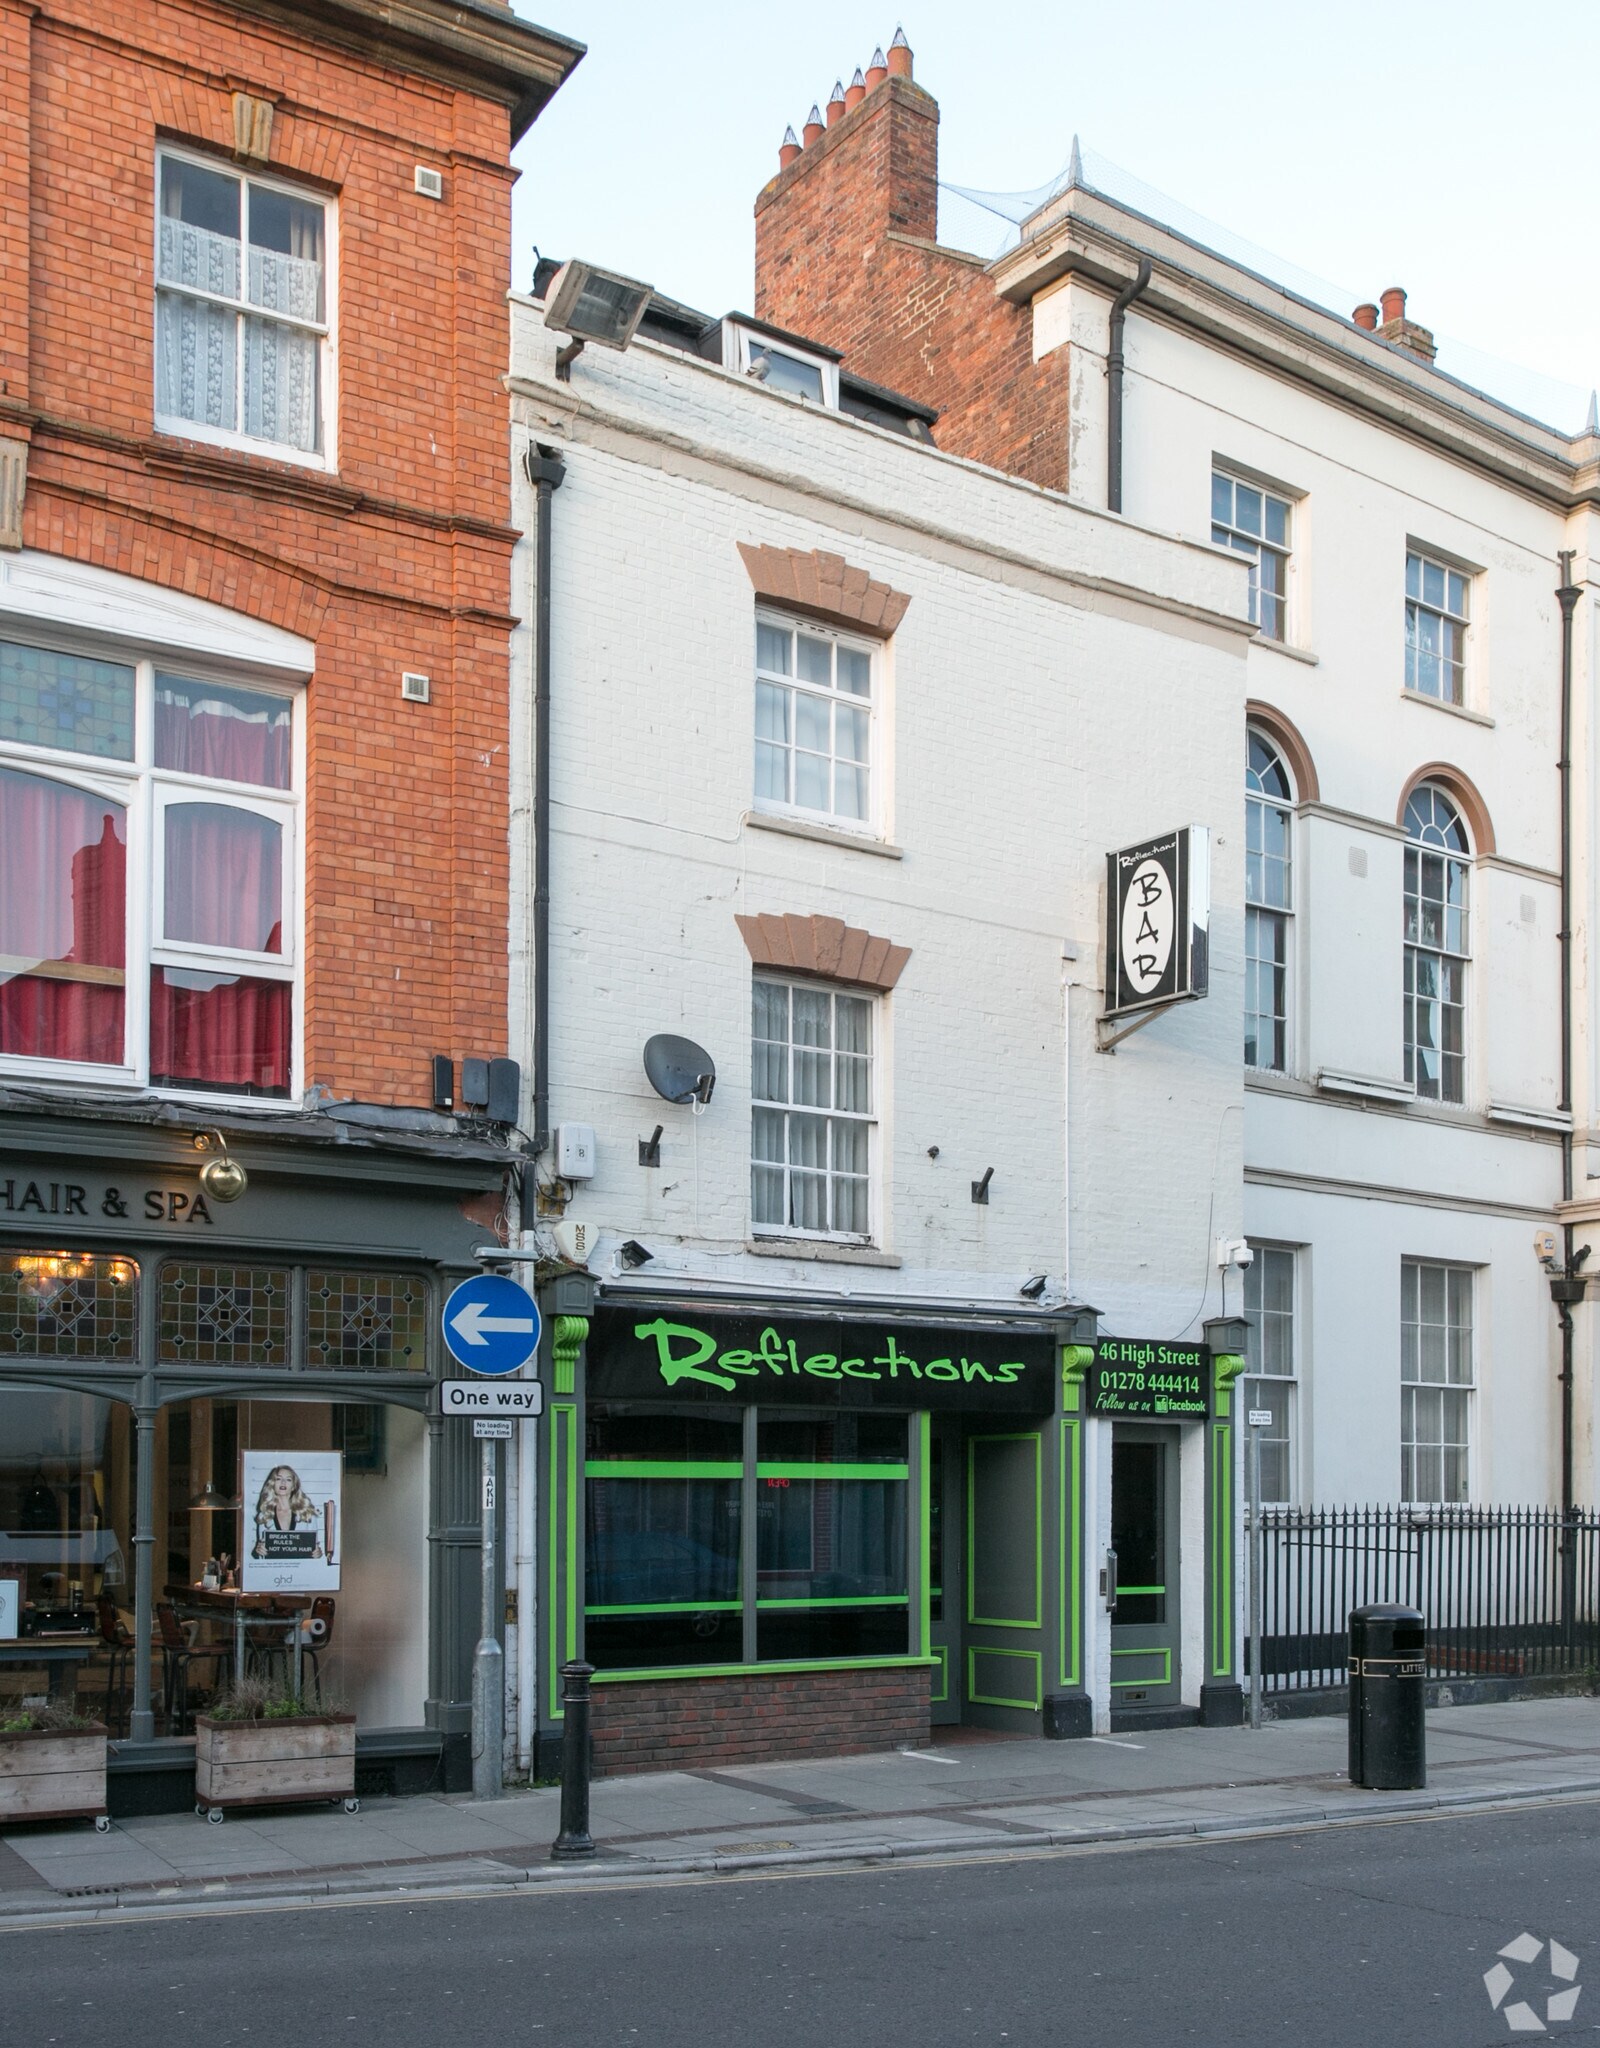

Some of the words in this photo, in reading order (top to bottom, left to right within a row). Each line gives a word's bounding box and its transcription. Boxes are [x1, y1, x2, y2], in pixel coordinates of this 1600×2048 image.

[1119, 842, 1176, 868] Reflections
[1132, 873, 1162, 979] BAR
[102, 1187, 129, 1218] &
[145, 1190, 213, 1224] SPA
[575, 1224, 585, 1250] MSS
[634, 1318, 1026, 1391] Reflections
[1099, 1342, 1118, 1360] 46
[1121, 1343, 1155, 1369] High
[1158, 1346, 1201, 1366] Street
[1100, 1371, 1145, 1391] 01278
[1147, 1373, 1200, 1393] 444414
[450, 1388, 489, 1406] One
[496, 1393, 535, 1409] way
[1095, 1392, 1126, 1409] Follow
[1128, 1400, 1139, 1411] us
[1141, 1401, 1151, 1412] on
[1169, 1399, 1206, 1412] facebook
[486, 1478, 494, 1507] AKH
[273, 1575, 293, 1588] ghd
